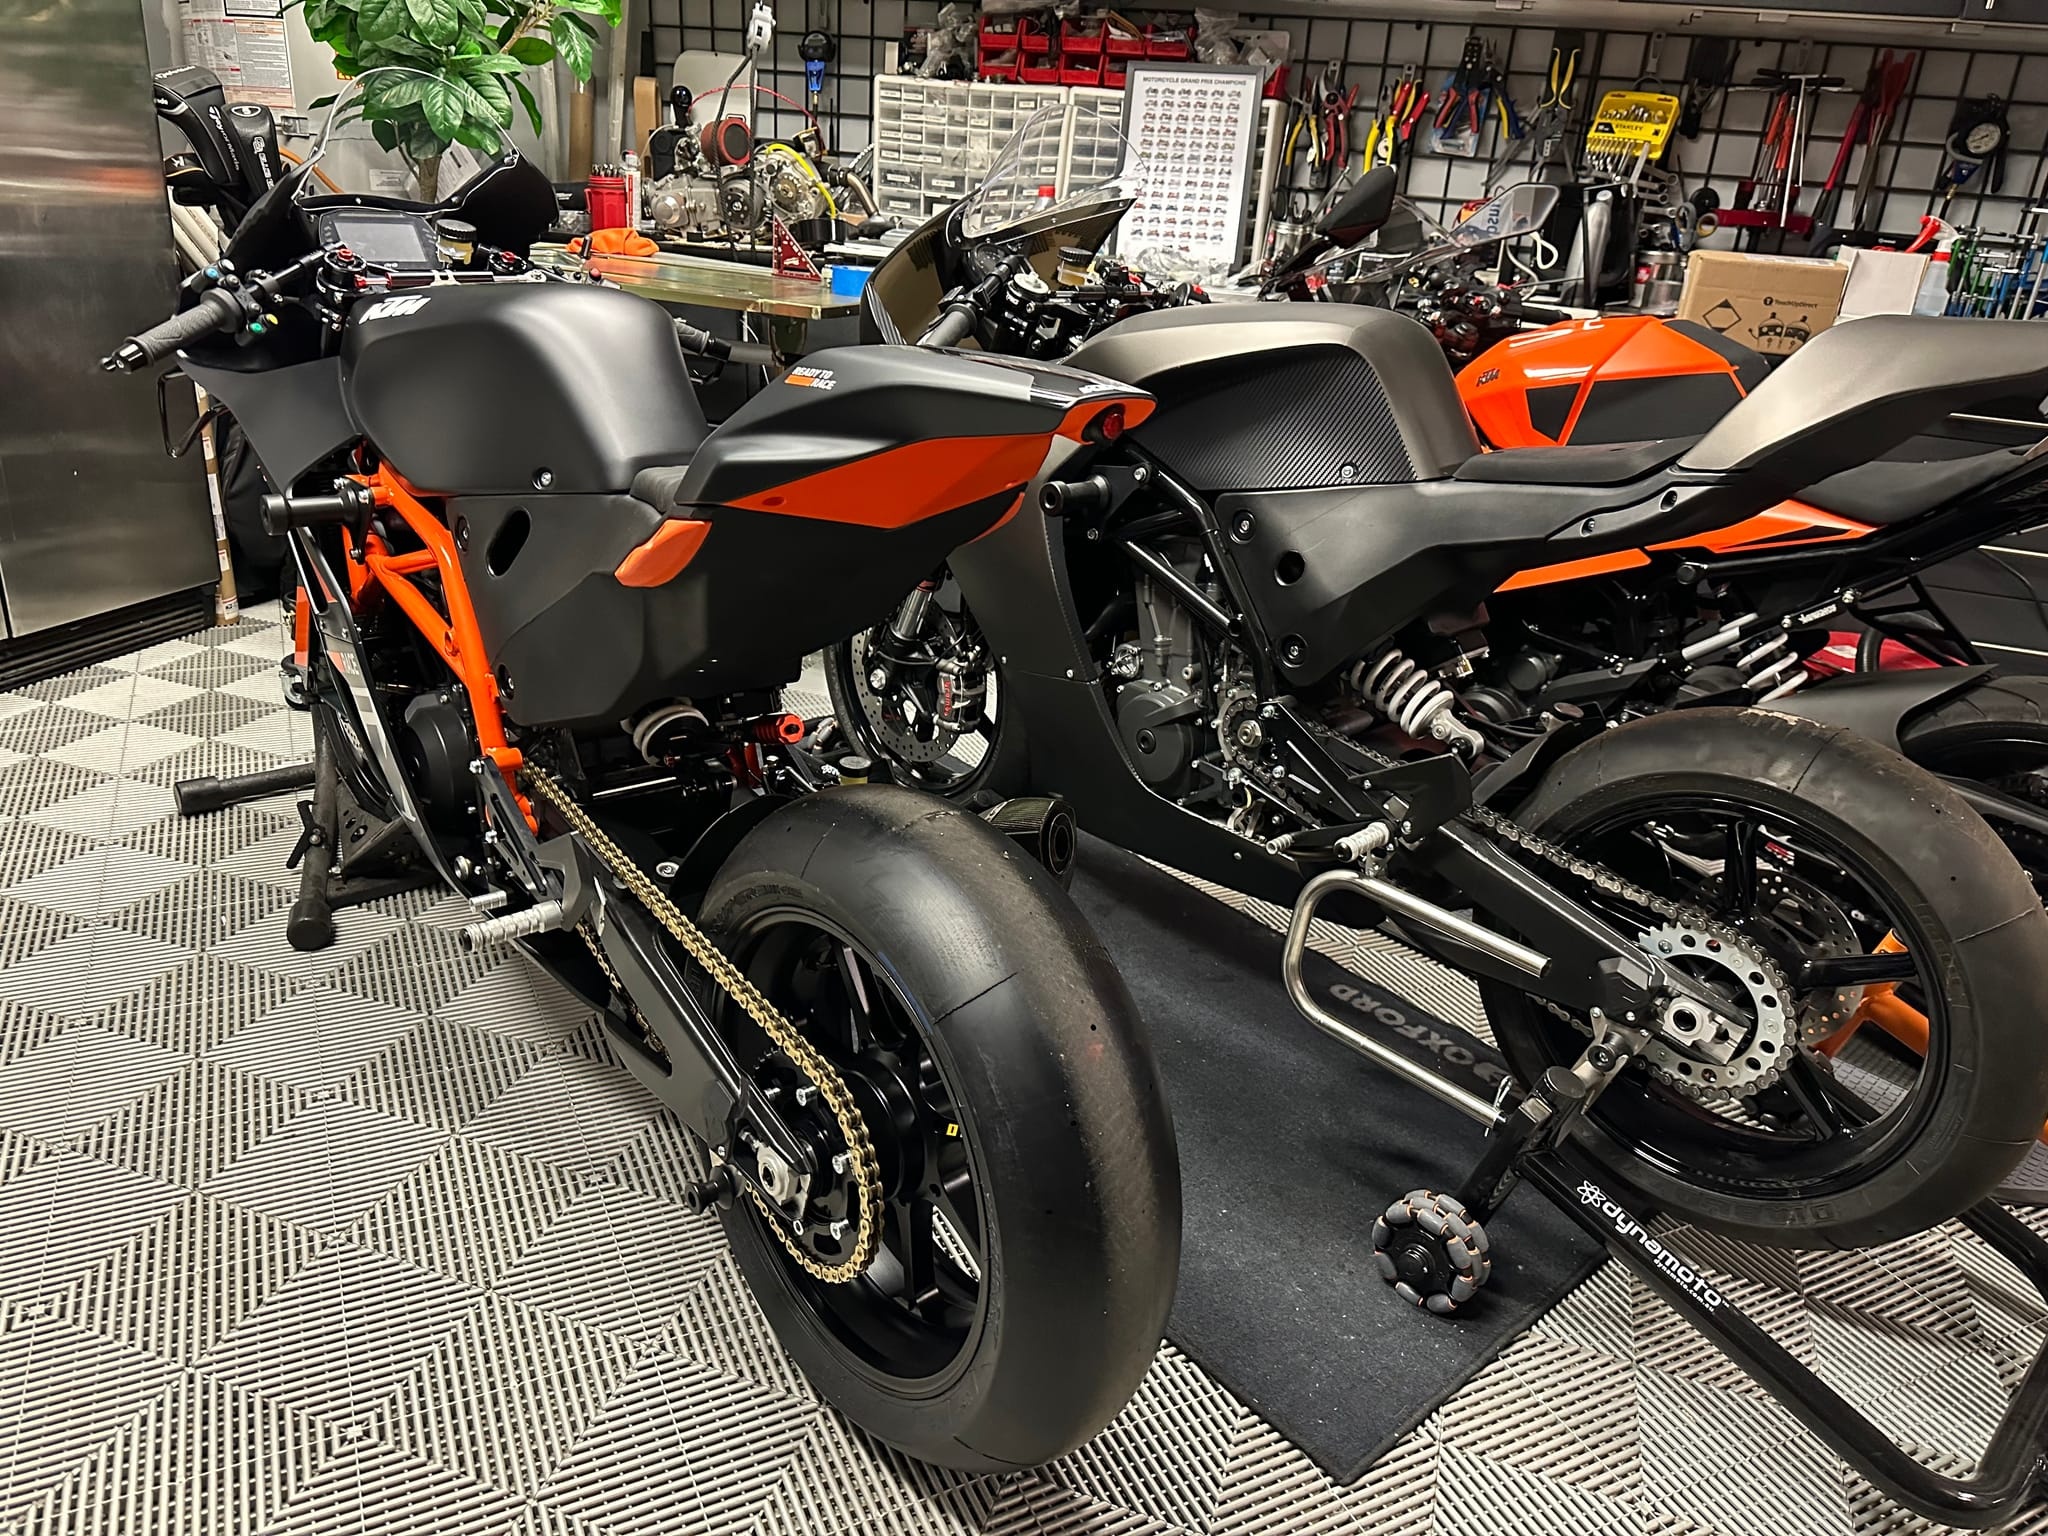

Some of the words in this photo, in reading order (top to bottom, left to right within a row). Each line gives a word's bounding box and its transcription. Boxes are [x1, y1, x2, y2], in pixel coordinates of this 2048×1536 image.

[1143, 76, 1180, 84] MOTORCYCLE
[1615, 123, 1644, 131] STANLEY
[358, 294, 432, 325] KTM
[791, 366, 822, 378] READY
[818, 369, 834, 380] TO
[1476, 367, 1500, 387] KTM
[810, 377, 837, 390] RACE
[1329, 984, 1475, 1065] OXFORD
[1602, 1201, 1722, 1307] dynamoto
[1653, 1258, 1715, 1313] dynamoto.com.au
